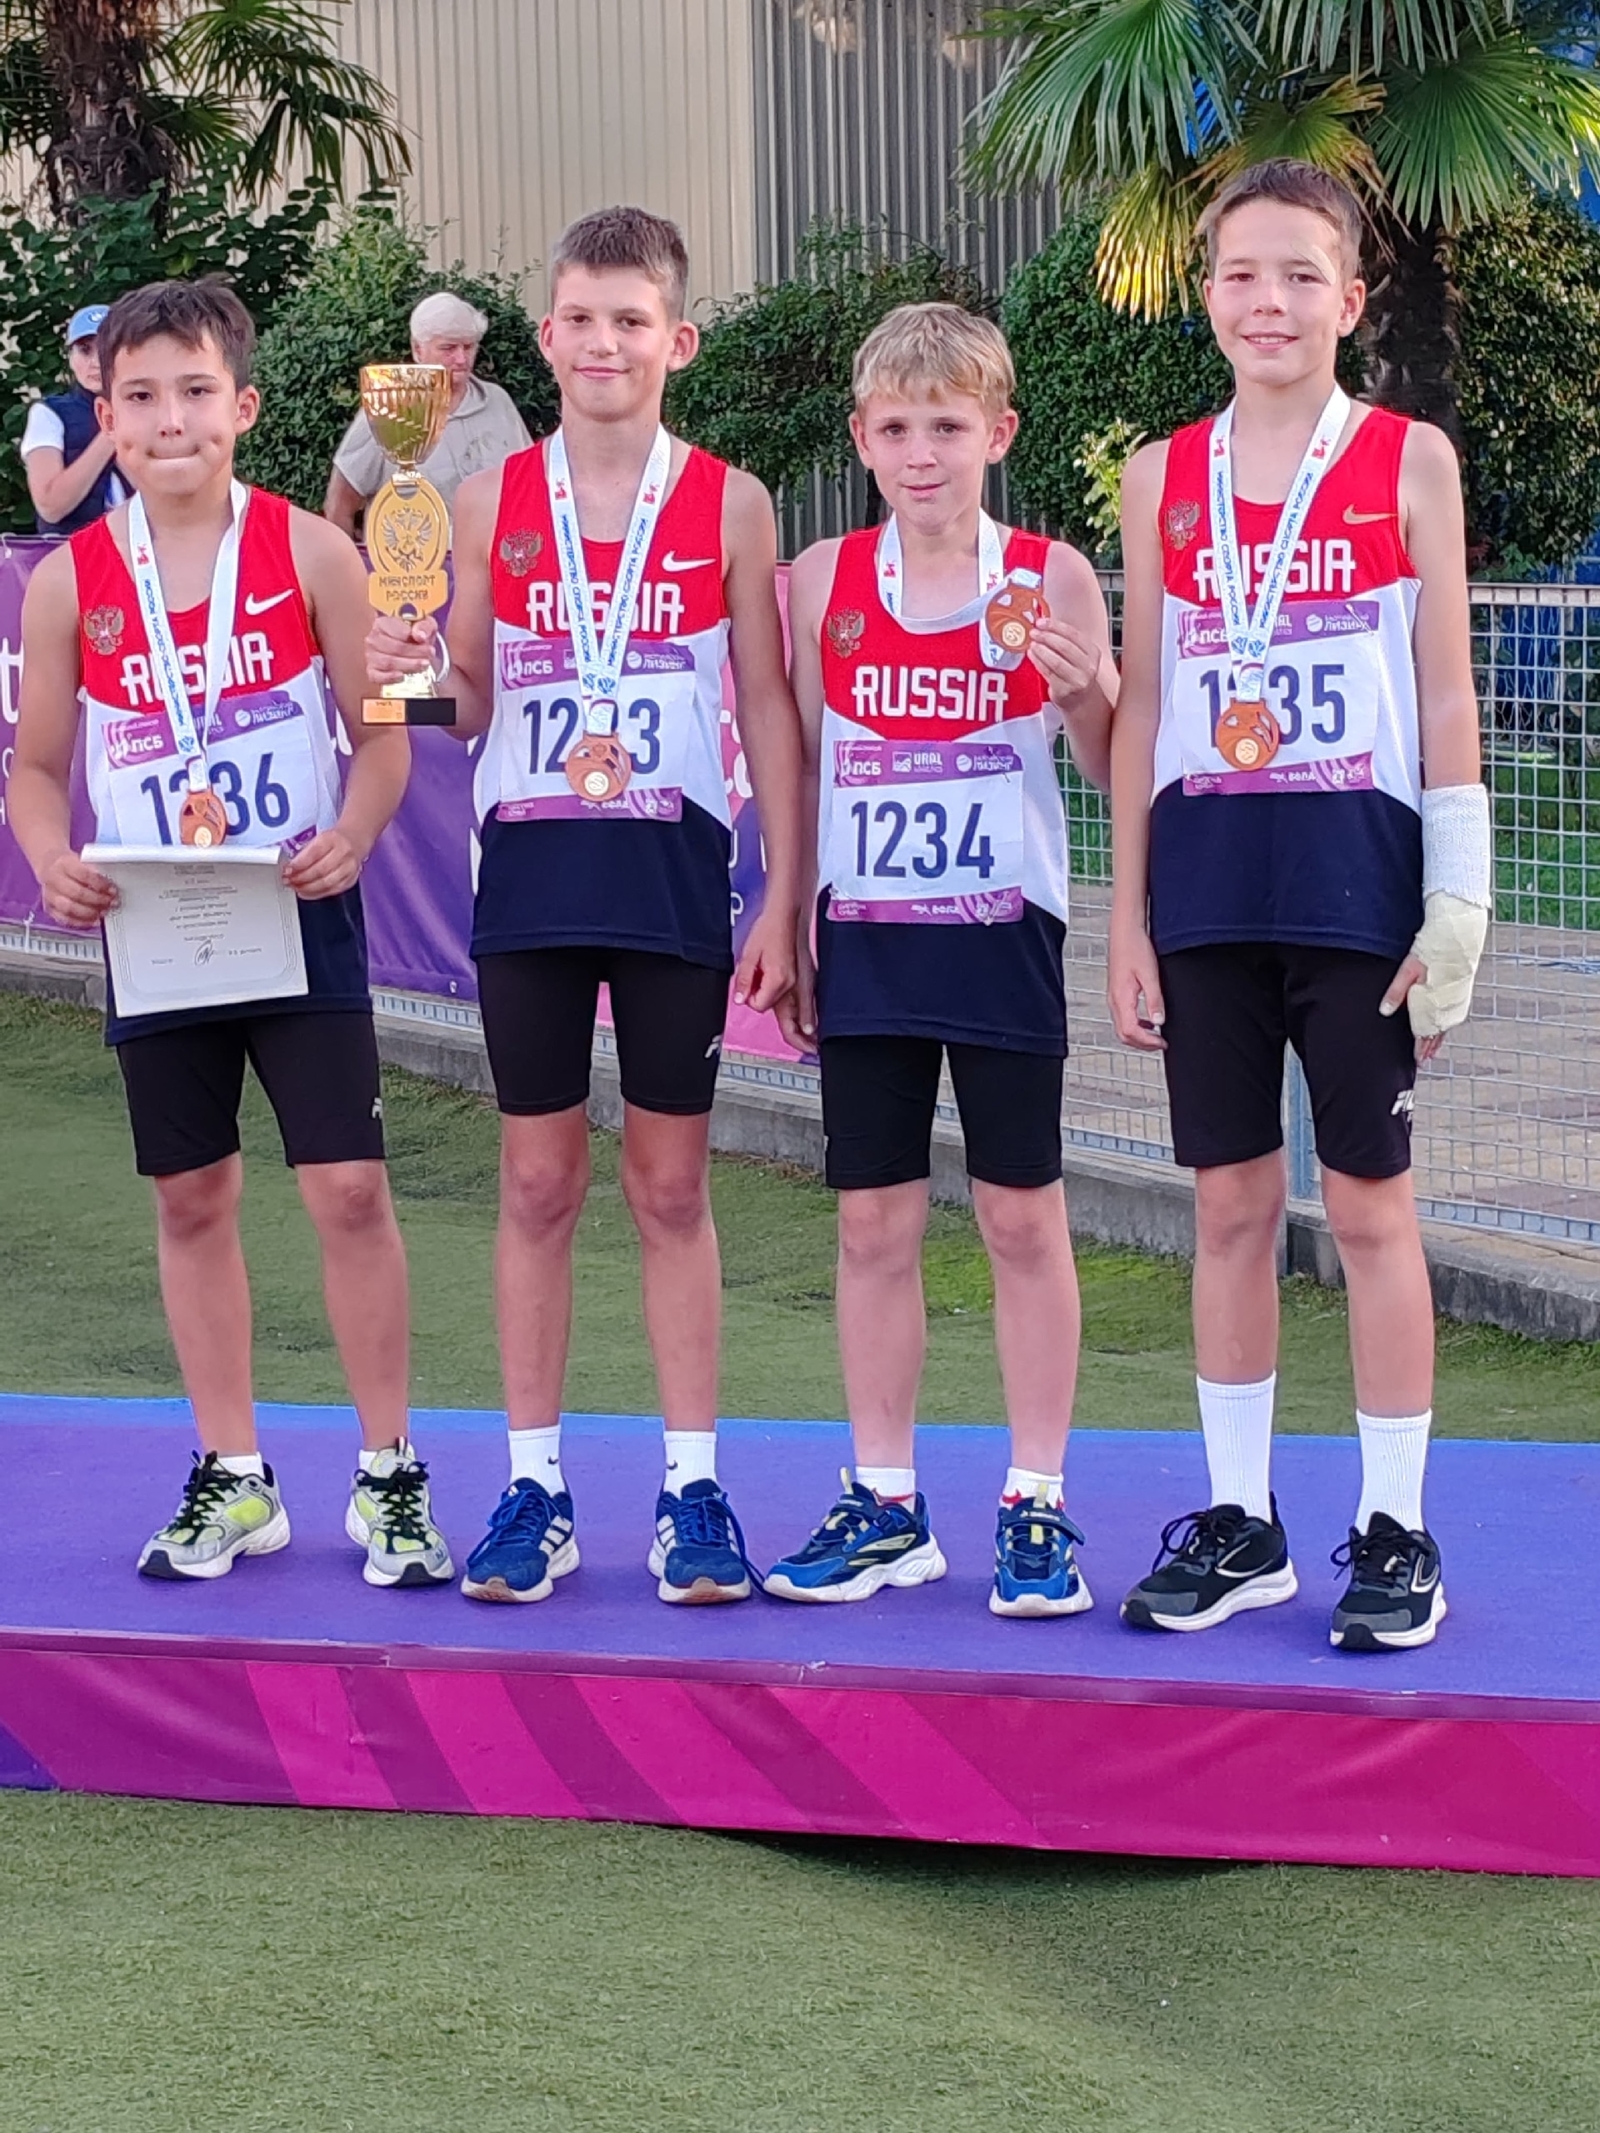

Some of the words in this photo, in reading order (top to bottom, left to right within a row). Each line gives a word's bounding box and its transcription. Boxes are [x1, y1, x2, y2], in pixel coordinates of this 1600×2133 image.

[379, 575, 435, 588] МИНСПОРТ
[386, 590, 428, 602] РОССИИ
[852, 665, 1009, 722] RUSSIA
[1200, 664, 1346, 748] 135
[522, 697, 662, 775] 123
[140, 751, 291, 846] 136
[851, 801, 995, 878] 1234
[1390, 1090, 1415, 1115] FIL
